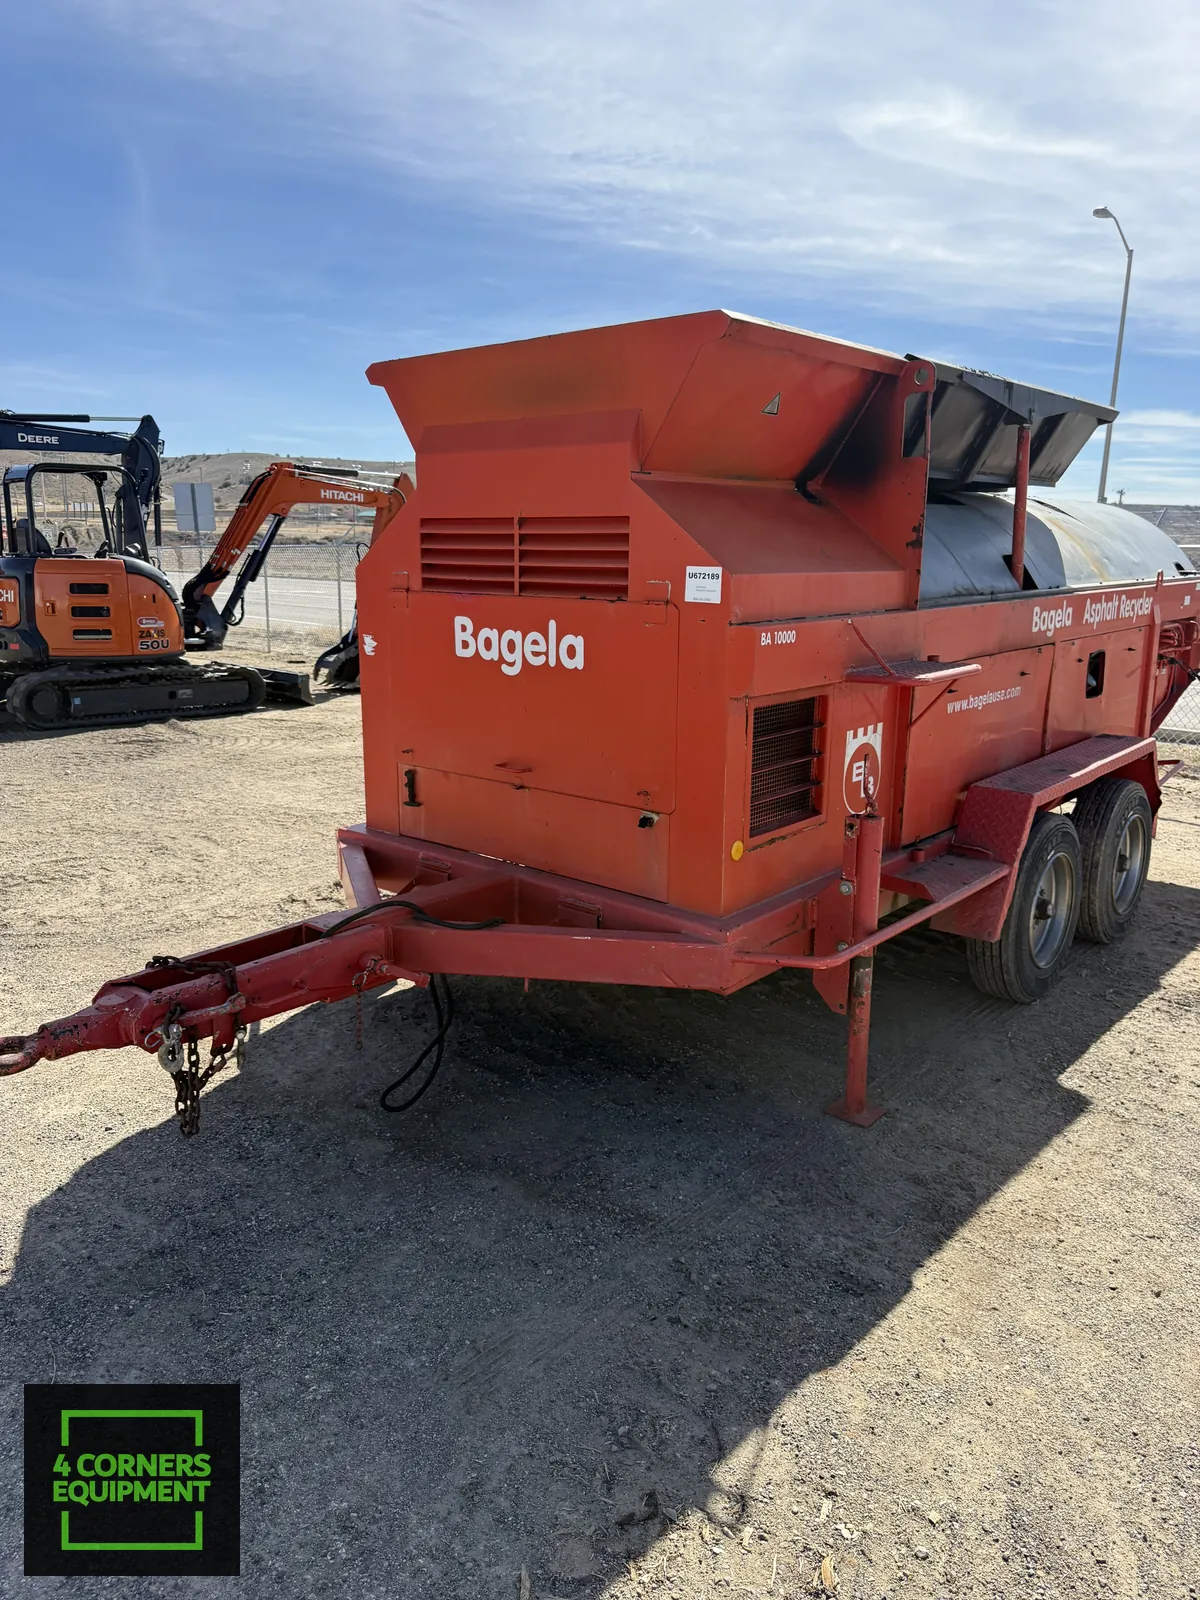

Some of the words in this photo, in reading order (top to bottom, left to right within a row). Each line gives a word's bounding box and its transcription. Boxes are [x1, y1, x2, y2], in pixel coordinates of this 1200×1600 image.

[17, 432, 60, 445] DEERE
[320, 489, 364, 503] HITACHI
[688, 572, 720, 580] U672189
[1031, 600, 1073, 637] Bagela
[1082, 593, 1119, 630] Asphalt
[1119, 590, 1154, 624] Recycler
[139, 638, 170, 651] 50U
[760, 632, 772, 646] BA
[774, 630, 796, 645] 10000
[453, 615, 585, 676] Bagela
